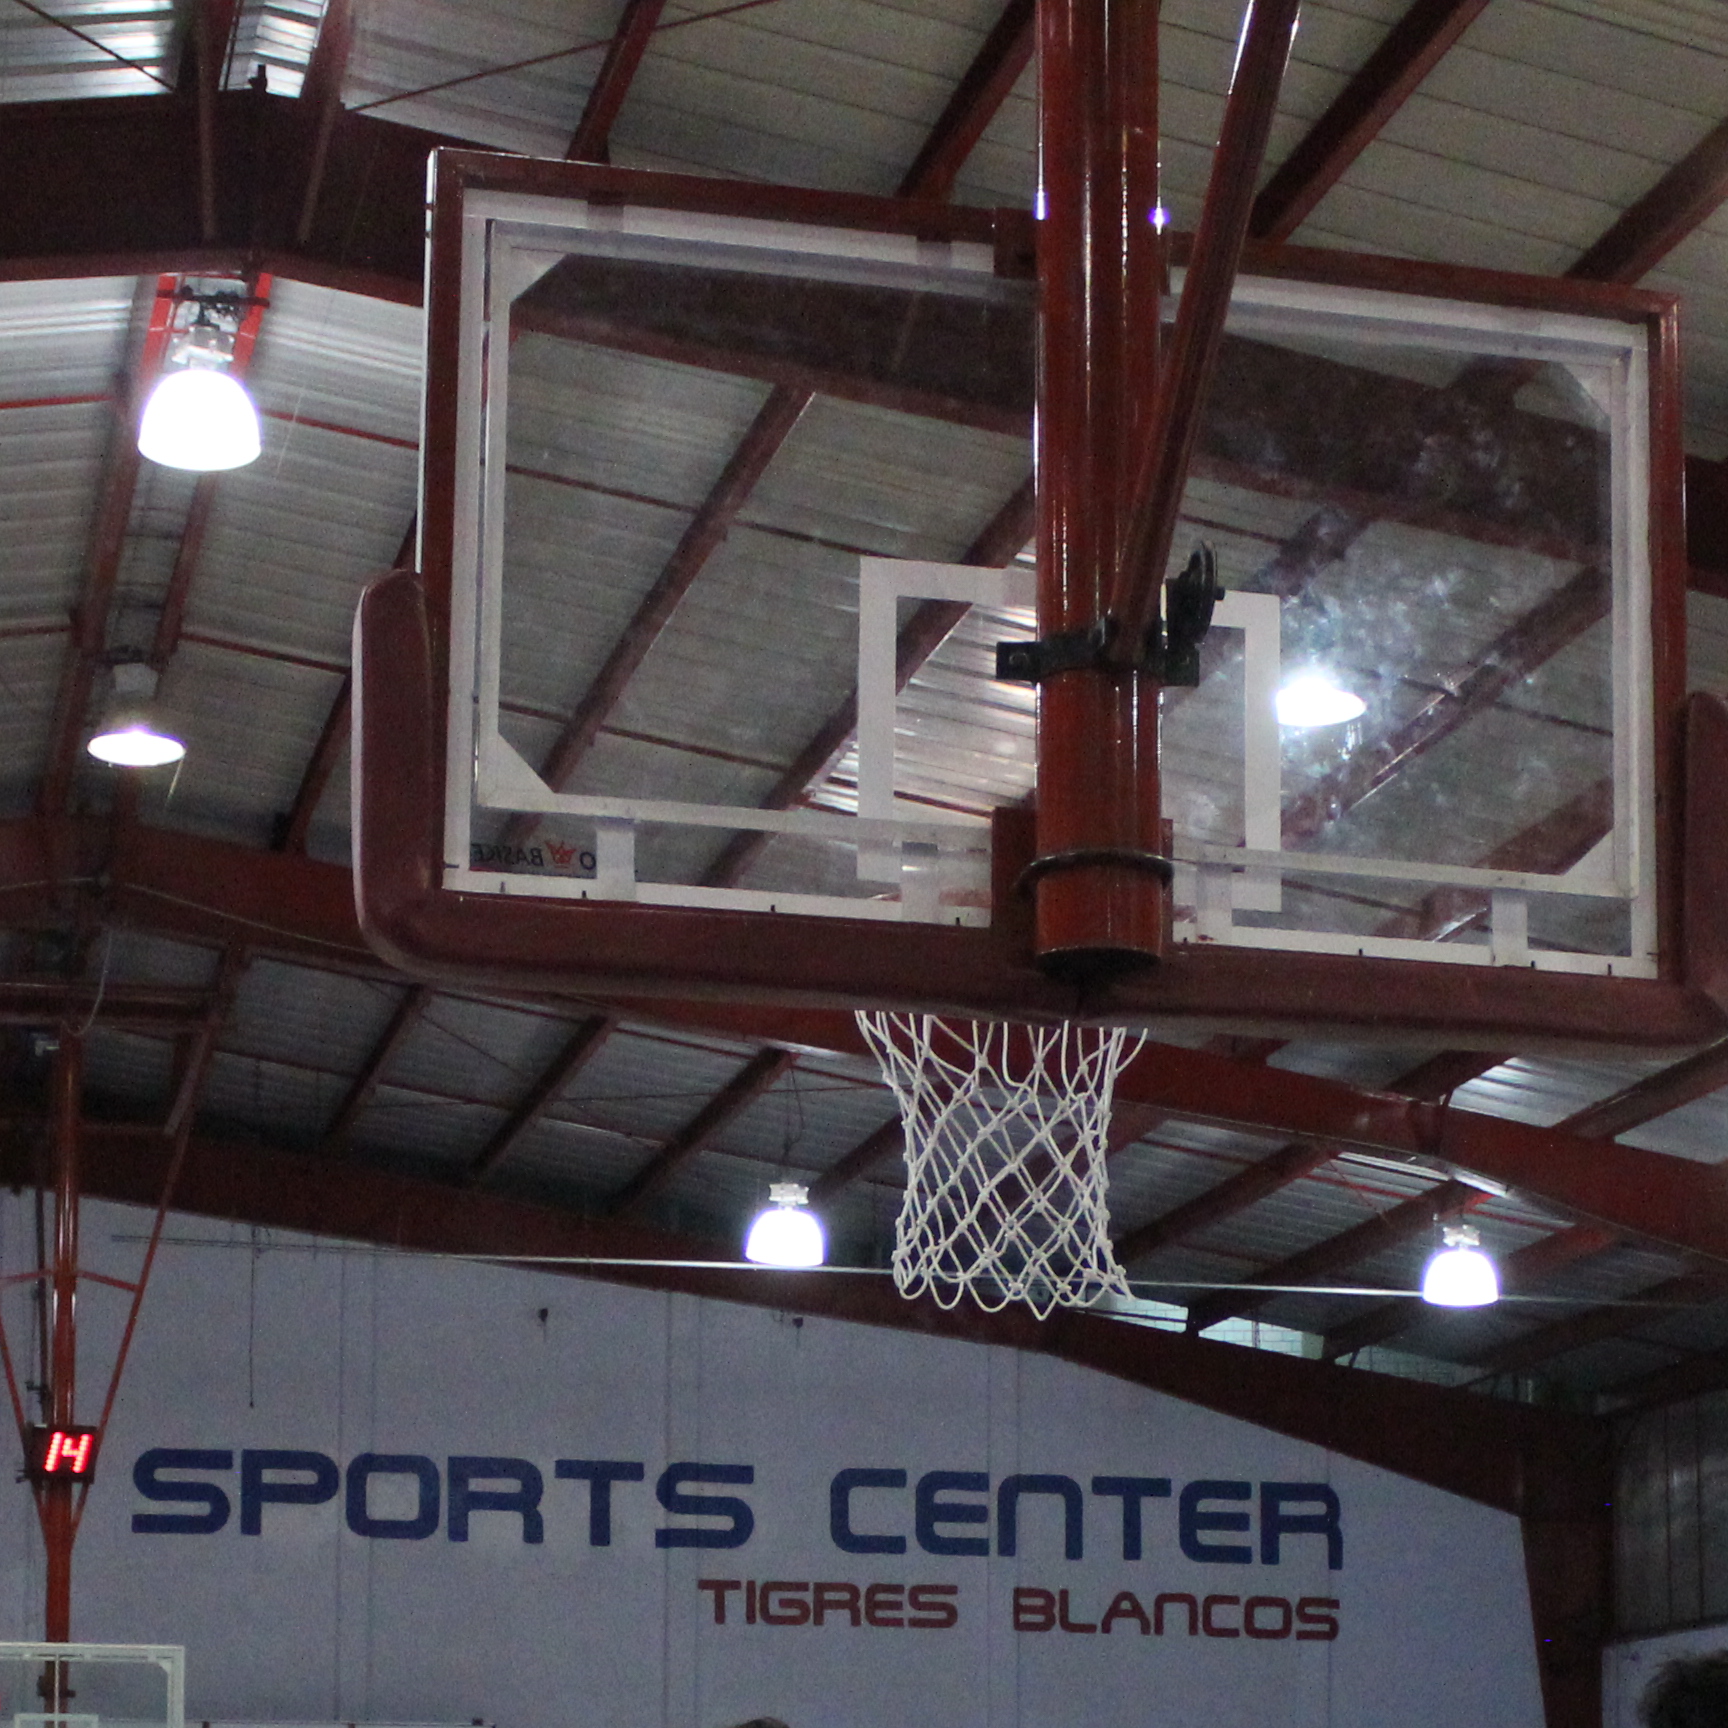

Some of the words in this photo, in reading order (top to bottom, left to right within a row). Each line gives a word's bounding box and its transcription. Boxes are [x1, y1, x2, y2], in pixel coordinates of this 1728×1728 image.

[44, 1431, 94, 1474] 14
[131, 1447, 755, 1549] SPORTS
[830, 1467, 1344, 1570] CENTER
[697, 1579, 959, 1628] TIGRES
[1012, 1586, 1341, 1641] BLANCOS
